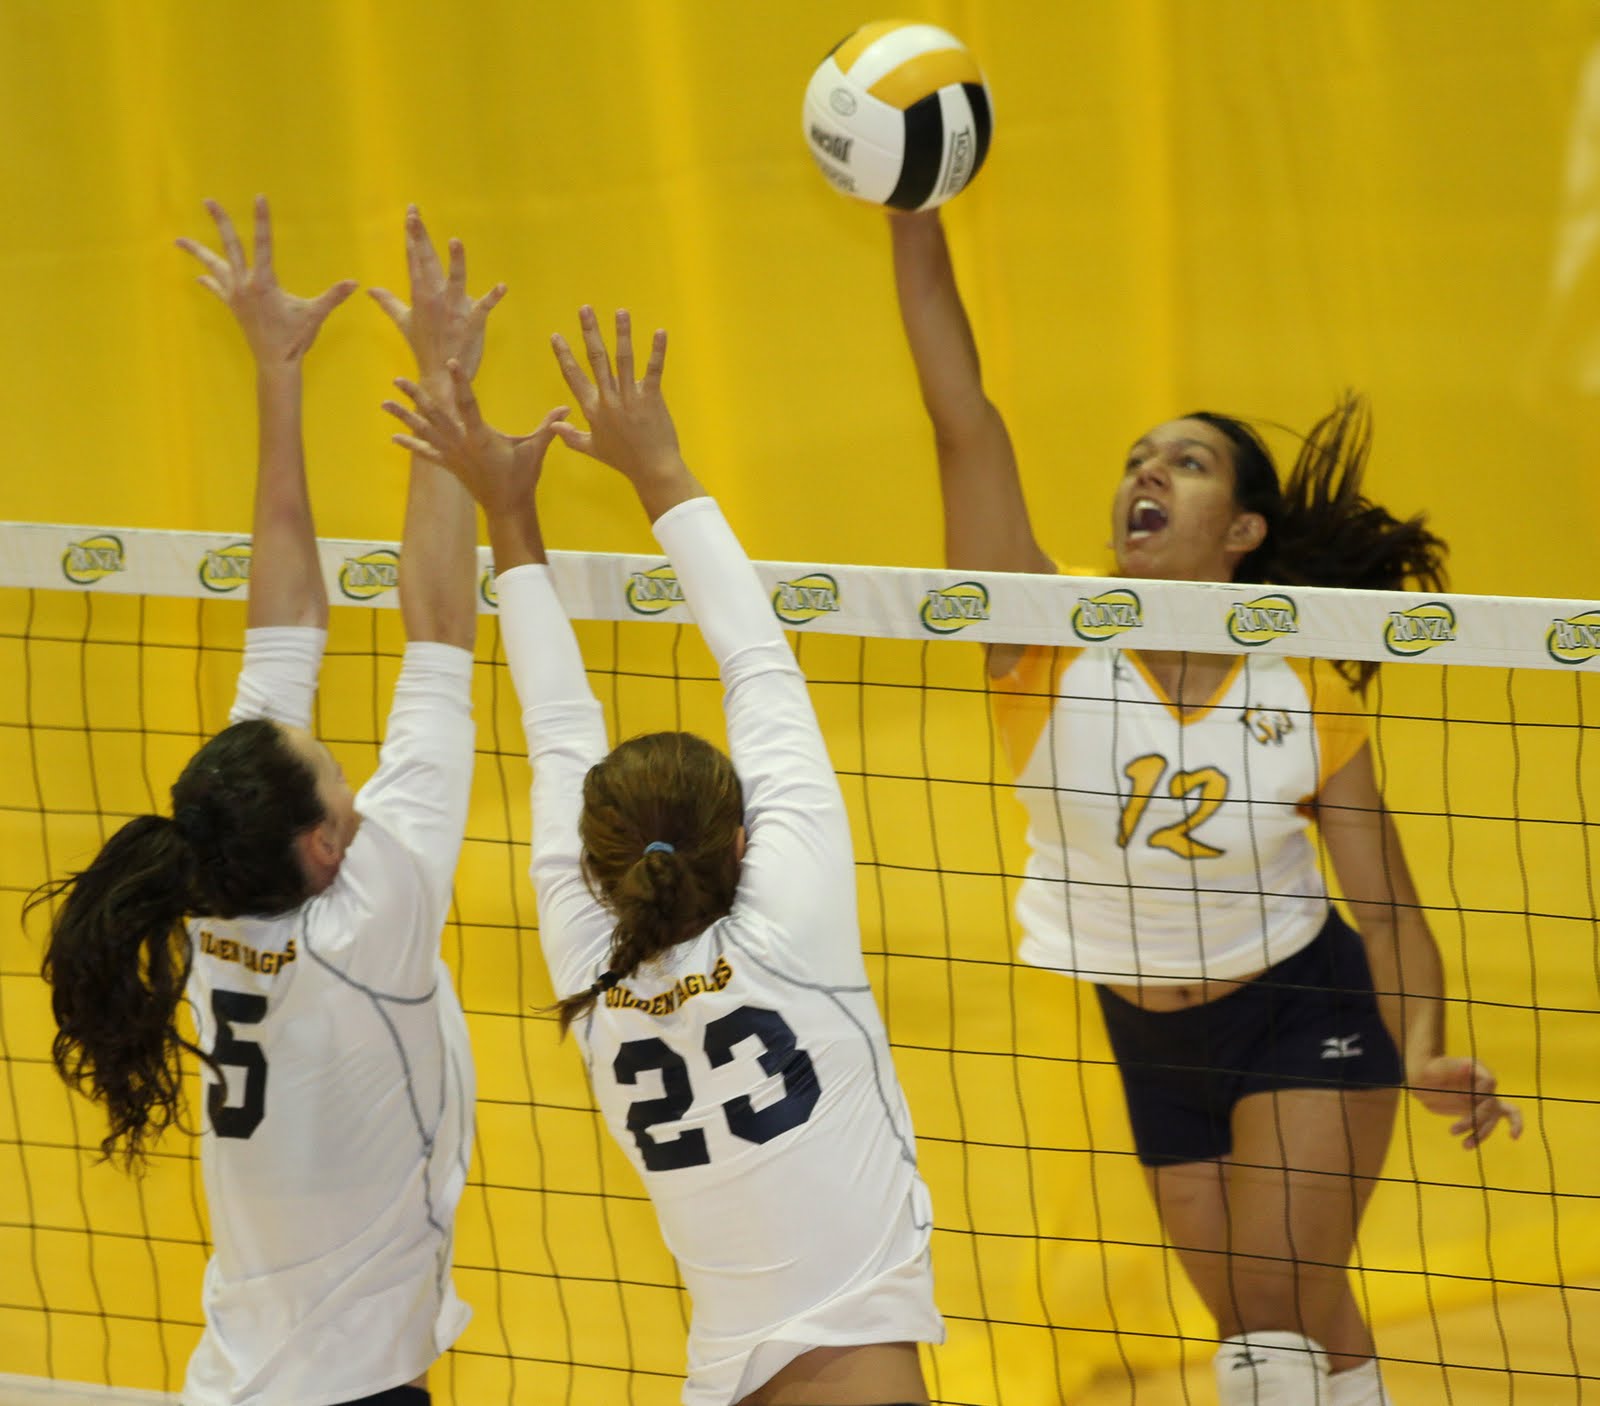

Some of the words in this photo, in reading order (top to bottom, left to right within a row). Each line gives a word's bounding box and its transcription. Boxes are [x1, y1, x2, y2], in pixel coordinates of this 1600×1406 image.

[69, 543, 126, 572] RUNZA
[207, 548, 250, 579] RUNZ
[344, 558, 398, 586] RUNZ
[632, 572, 685, 601] RUNZ
[778, 582, 840, 612] RUNZA
[929, 590, 989, 620] RUNZA
[1079, 598, 1144, 628] RUNZA
[1232, 602, 1299, 633] RUNZA
[1389, 611, 1456, 641] RUNZA
[1553, 619, 1600, 649] RUNZ
[1116, 753, 1230, 861] 12
[674, 954, 732, 1007] AGLES
[207, 988, 268, 1140] 5
[612, 1005, 822, 1173] 23
